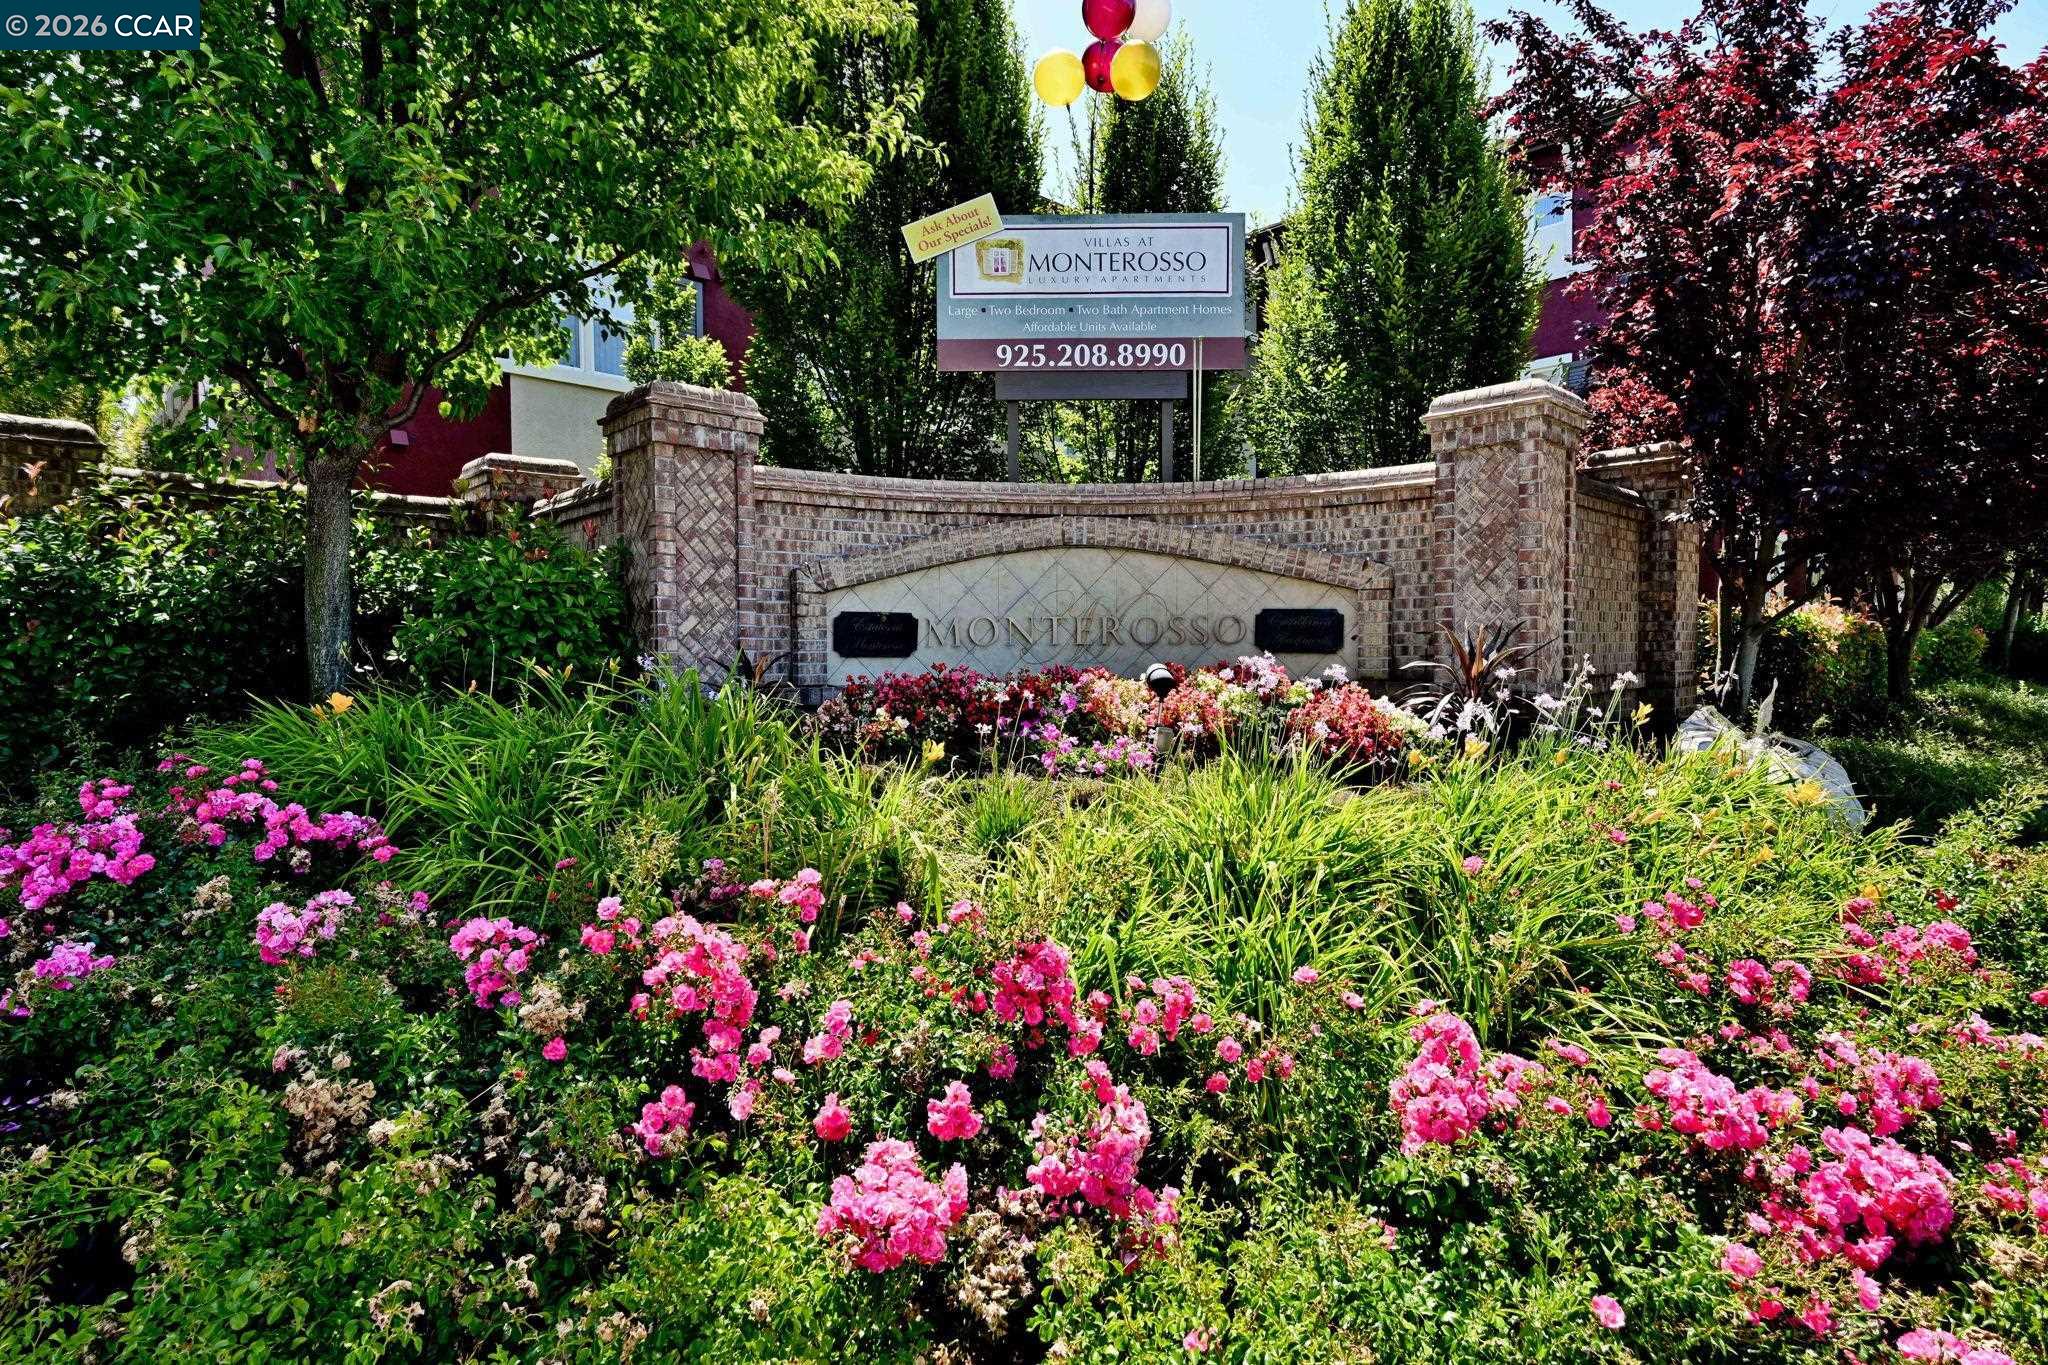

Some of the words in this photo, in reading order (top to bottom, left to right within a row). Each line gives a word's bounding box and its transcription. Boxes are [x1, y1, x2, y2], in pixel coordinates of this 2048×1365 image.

[918, 236, 942, 251] Our
[943, 215, 992, 243] Specials!
[921, 221, 944, 237] Ask
[946, 207, 980, 228] About
[1084, 237, 1130, 248] VILLAS
[1139, 236, 1155, 247] AT
[1028, 251, 1207, 273] MONTEROSSO
[1028, 276, 1090, 284] LUXURY
[1100, 275, 1206, 284] APARTMENTS
[948, 305, 978, 318] Large
[989, 305, 1012, 316] Two
[1015, 304, 1066, 316] Bedroom
[1077, 304, 1099, 315] Two
[1102, 304, 1128, 315] Bath
[1131, 304, 1189, 317] Apartment
[1193, 304, 1232, 315] Homes
[1023, 321, 1077, 332] Affordable
[1080, 321, 1106, 332] Units
[1110, 320, 1158, 332] Available
[996, 343, 1186, 368] 925.208.8990
[924, 614, 1248, 650] MONTEROSSO
